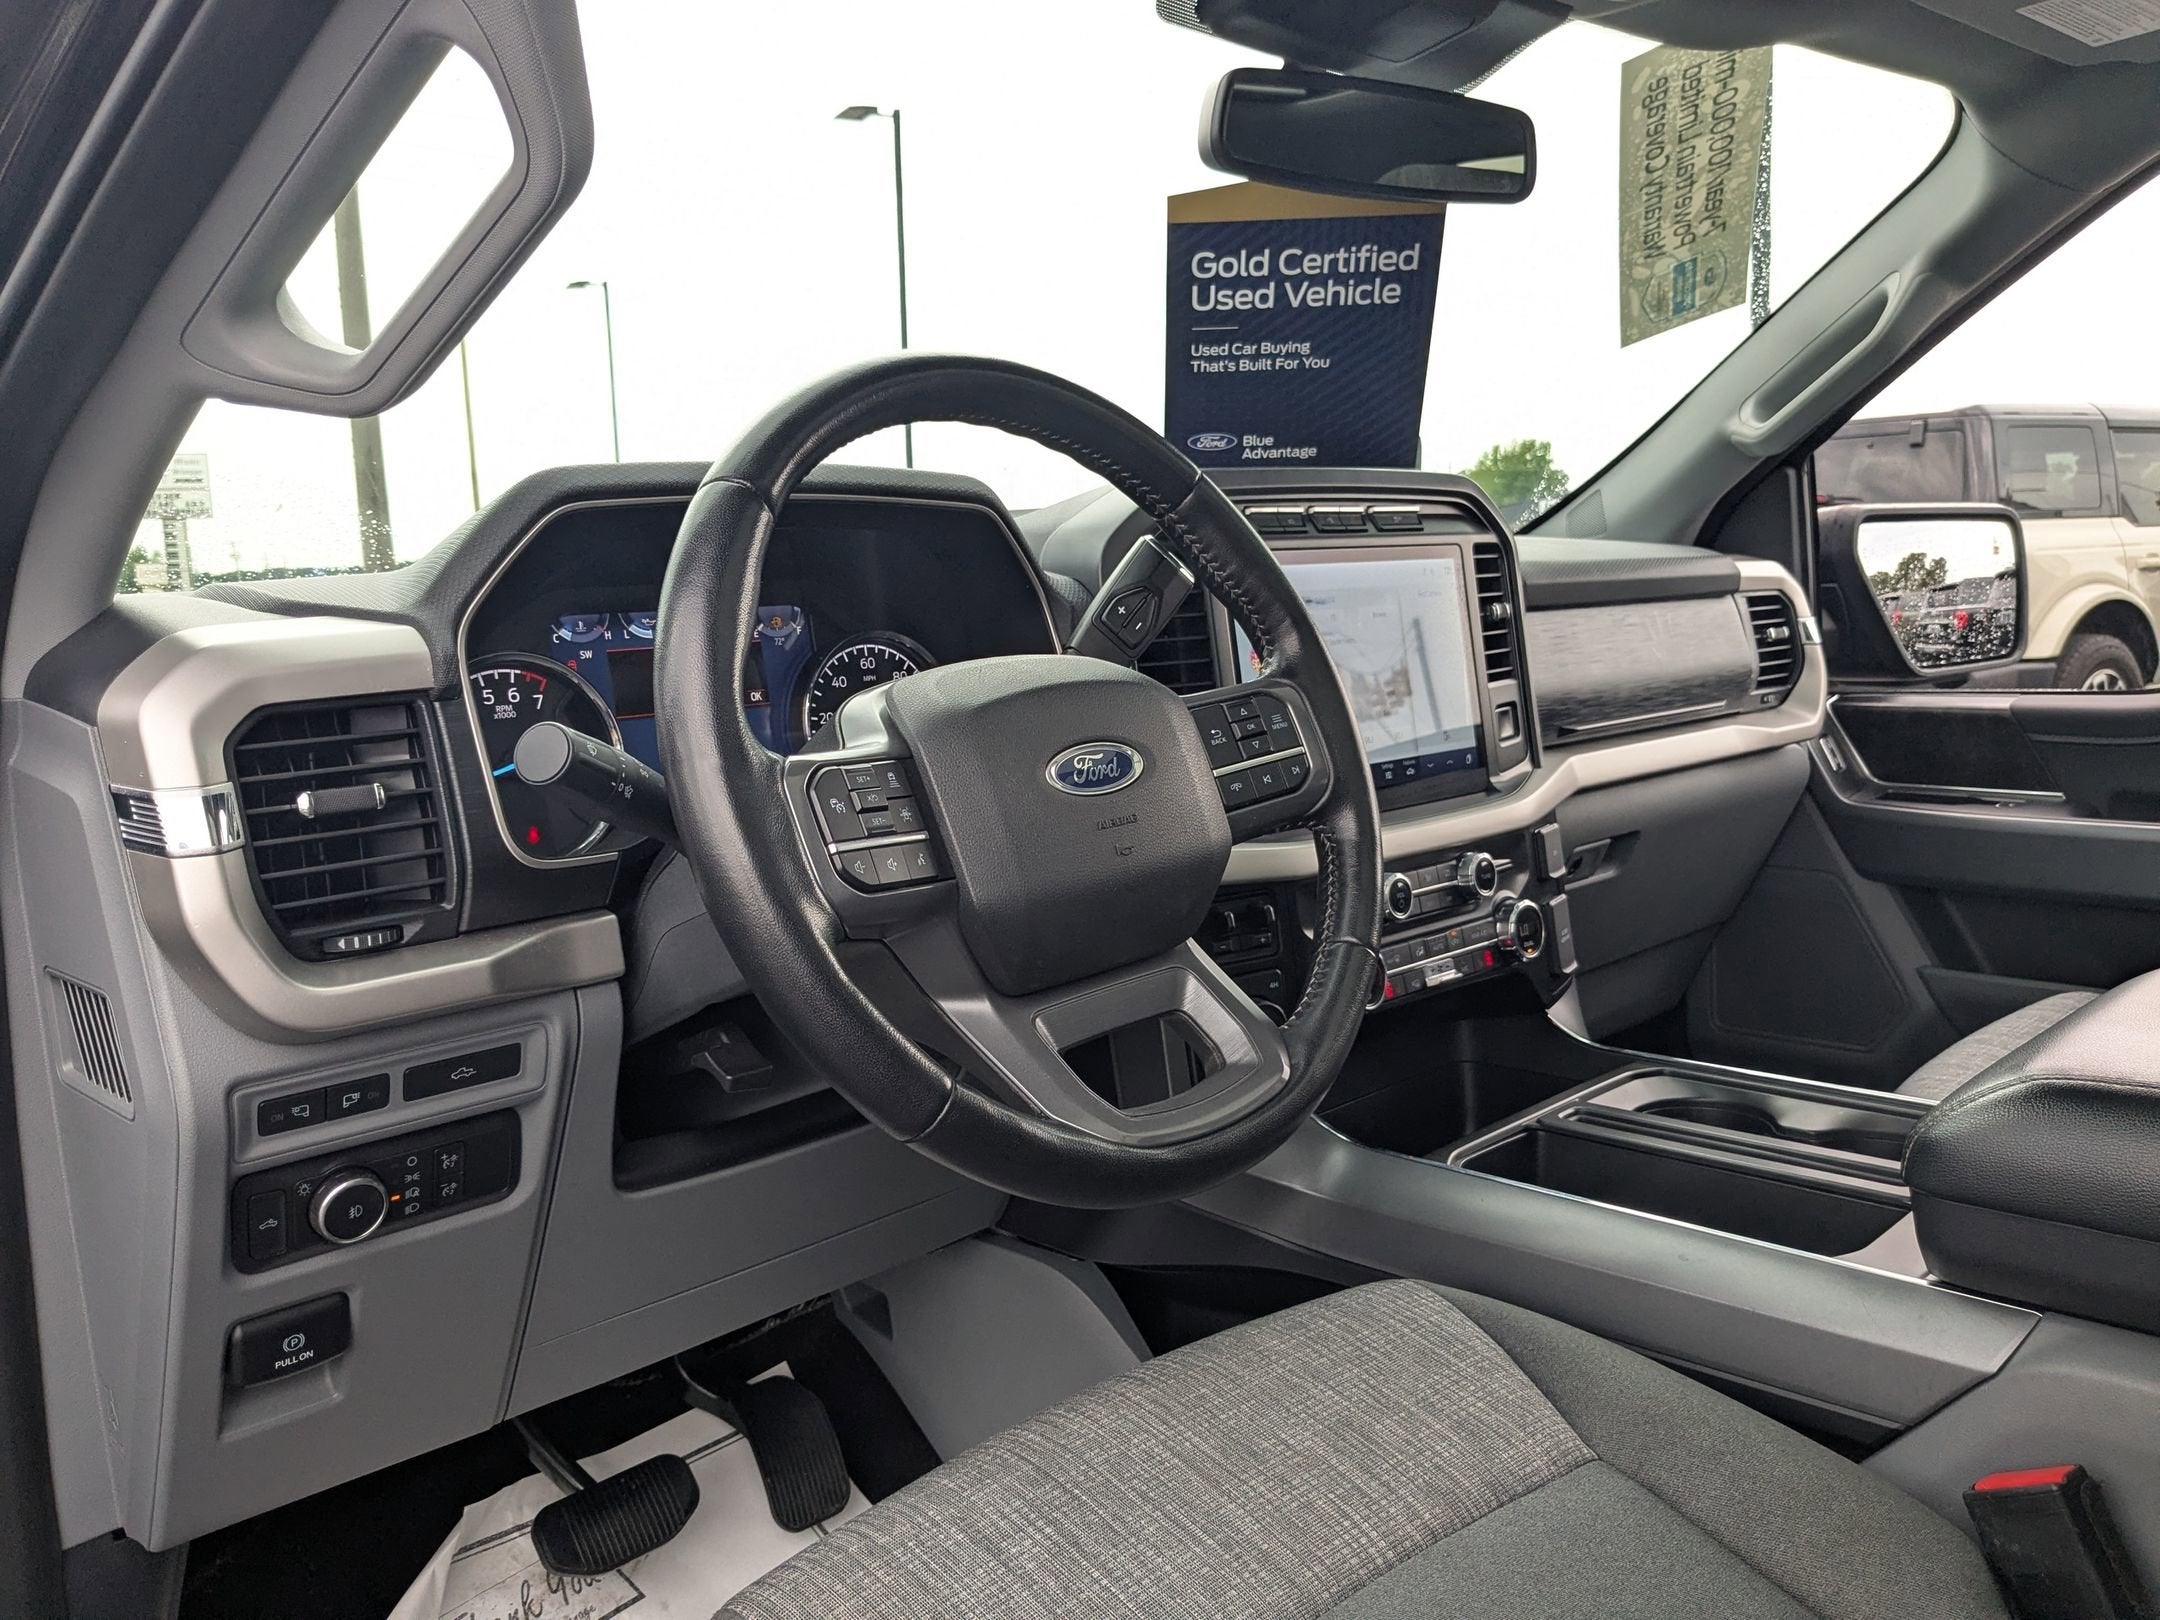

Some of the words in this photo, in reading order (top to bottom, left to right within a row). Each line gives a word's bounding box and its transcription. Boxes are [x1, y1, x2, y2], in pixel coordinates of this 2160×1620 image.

[1191, 249, 1270, 279] Gold
[1278, 243, 1420, 276] Certified
[1191, 281, 1275, 311] Used
[1285, 278, 1401, 308] Vehicle
[1191, 343, 1229, 357] Used
[1232, 343, 1257, 355] Car
[1260, 341, 1311, 356] Buying
[1191, 360, 1237, 374] That's
[1239, 358, 1272, 371] Built
[1275, 358, 1299, 370] For
[1302, 356, 1330, 369] You
[1242, 435, 1275, 447] Blue
[1241, 446, 1317, 459] Advantage
[552, 633, 560, 643] C
[604, 630, 612, 640] H
[623, 629, 631, 639] L
[579, 650, 593, 659] SW
[859, 656, 876, 669] 60
[831, 676, 848, 688] 40
[482, 689, 495, 705] 5
[507, 687, 520, 703] 6
[750, 691, 763, 701] OK
[532, 694, 544, 710] 7
[495, 704, 513, 713] RPM
[493, 711, 517, 720] x1000
[1271, 721, 1288, 730] MENU
[1210, 736, 1228, 746] BACK
[1073, 752, 1121, 784] Ford
[275, 1355, 299, 1370] PULL
[299, 1349, 314, 1361] ON
